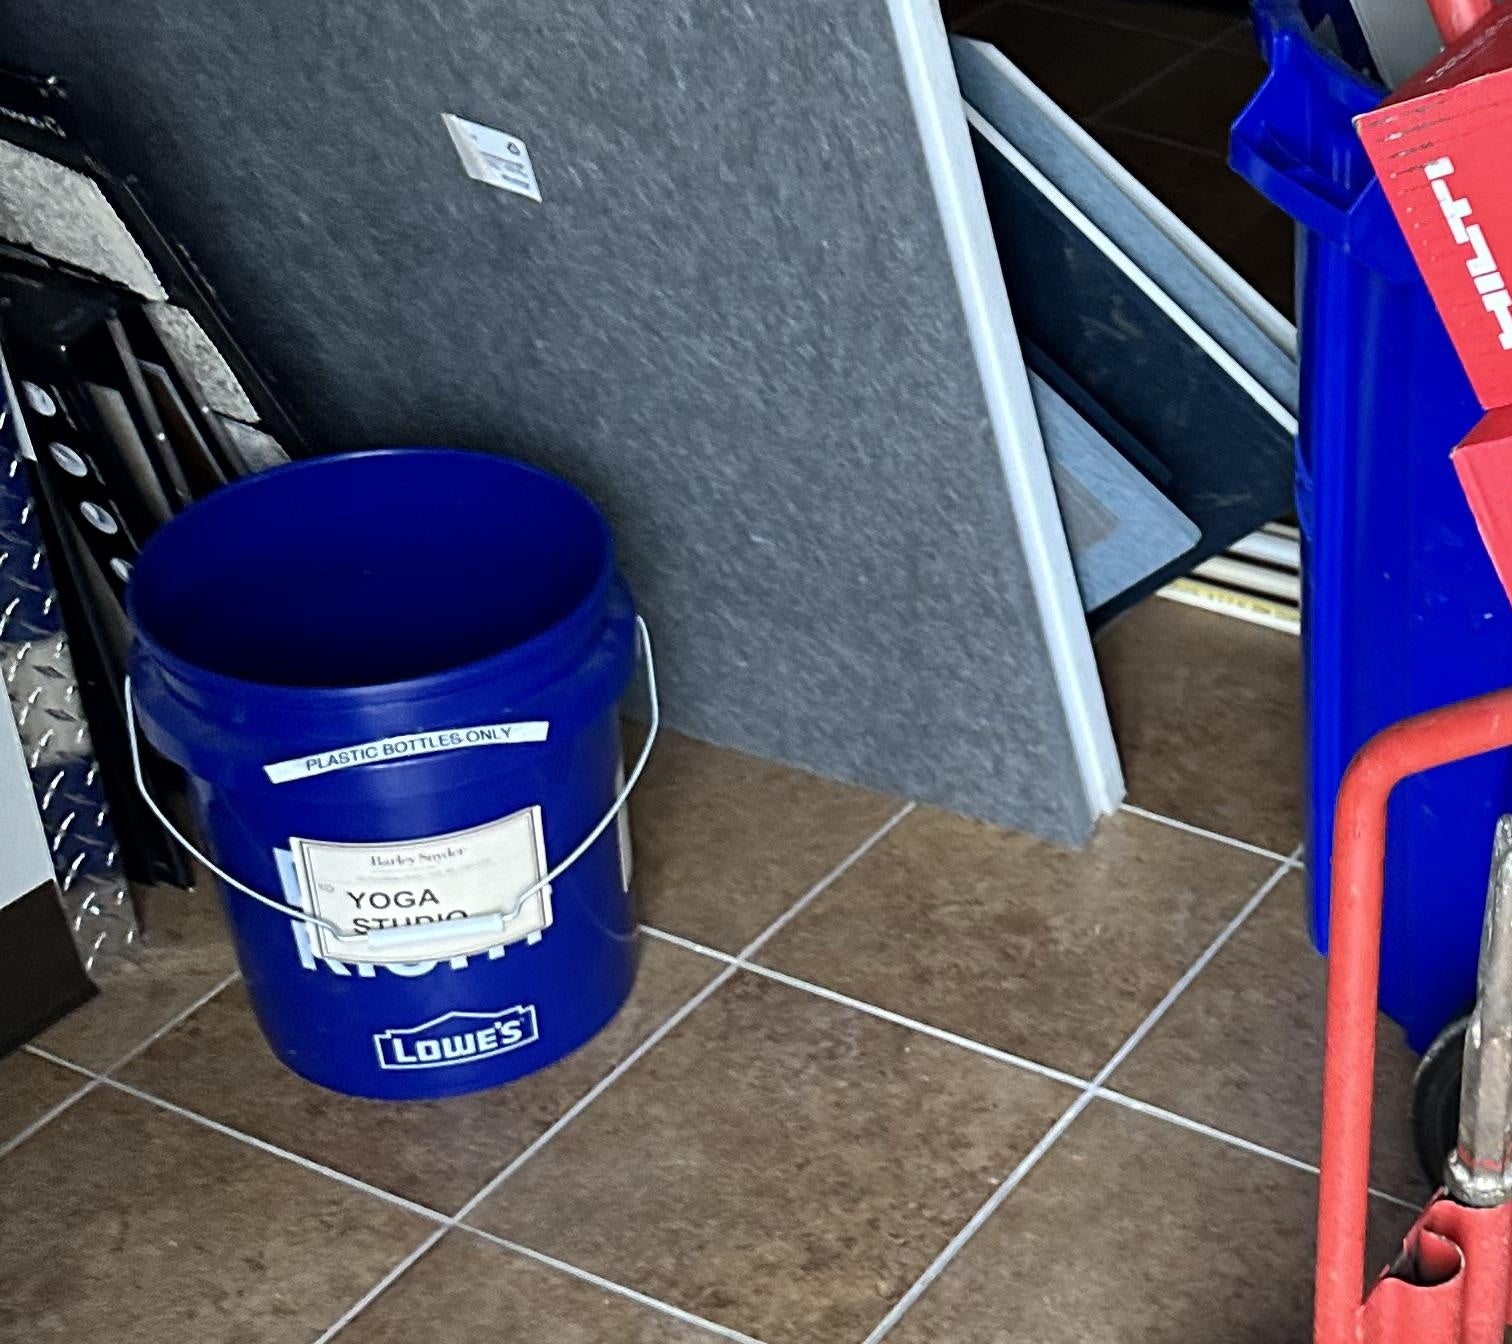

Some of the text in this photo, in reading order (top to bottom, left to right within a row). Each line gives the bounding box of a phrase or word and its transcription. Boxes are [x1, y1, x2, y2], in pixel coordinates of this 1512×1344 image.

[305, 726, 513, 772] PLASTIC BOTTLES ONLY
[346, 888, 441, 910] YOGA
[392, 1019, 523, 1064] LOWE'S
